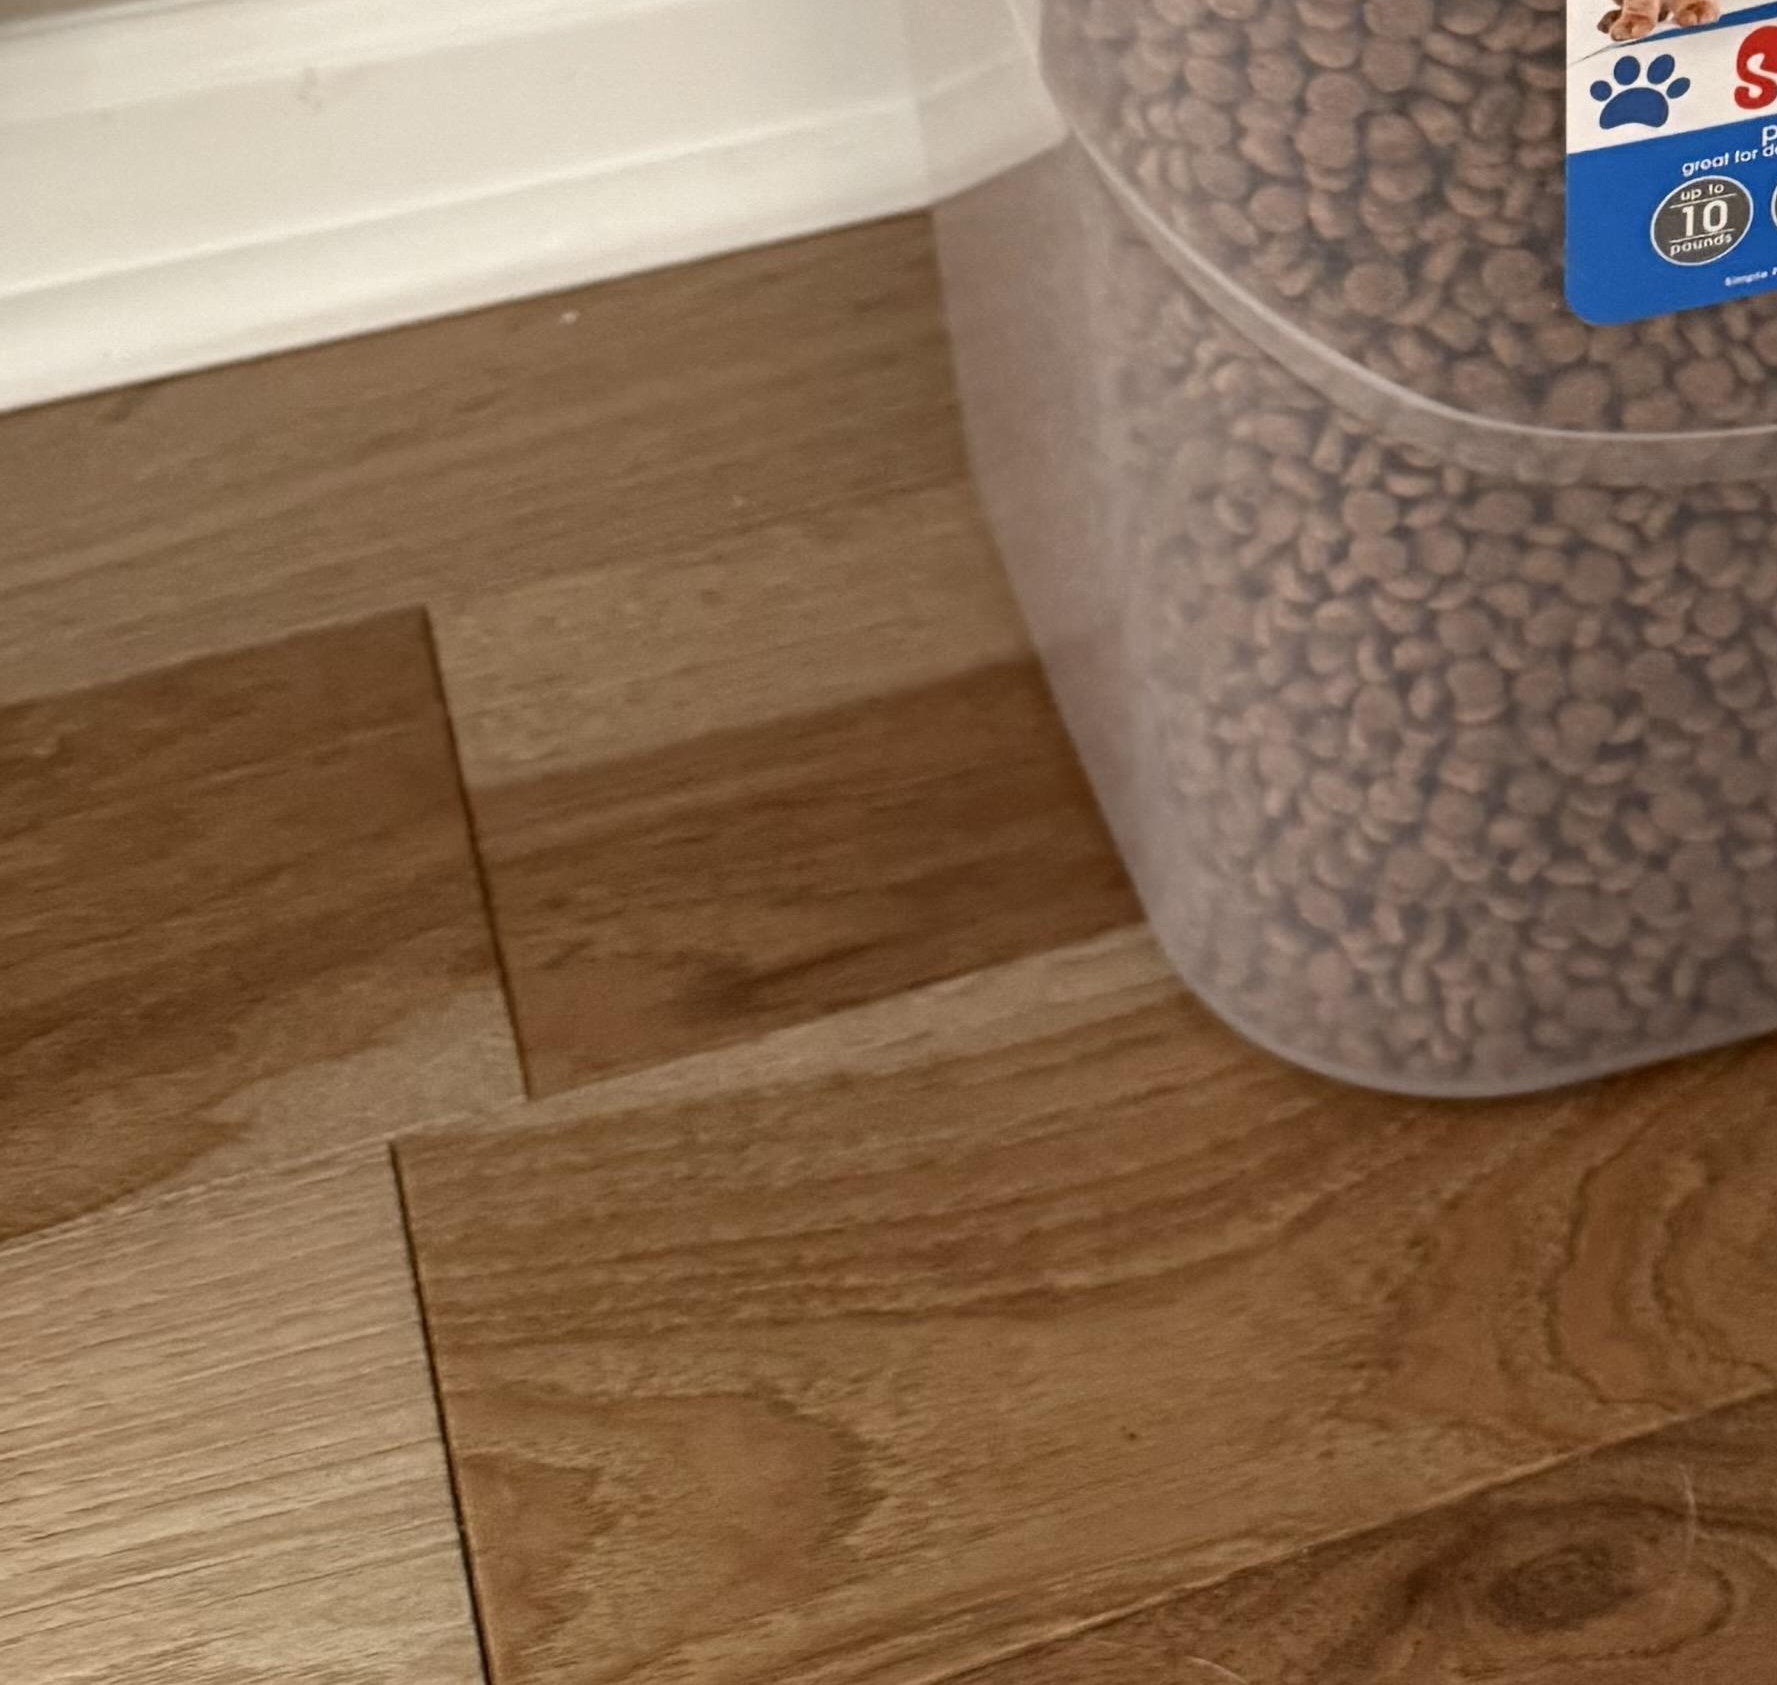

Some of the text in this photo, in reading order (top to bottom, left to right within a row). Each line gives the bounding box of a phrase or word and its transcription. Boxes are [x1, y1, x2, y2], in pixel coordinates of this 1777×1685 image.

[1682, 153, 1729, 177] great
[1735, 148, 1758, 164] for
[1680, 183, 1725, 202] up to
[1682, 200, 1728, 237] 10
[1670, 233, 1733, 257] pounds
